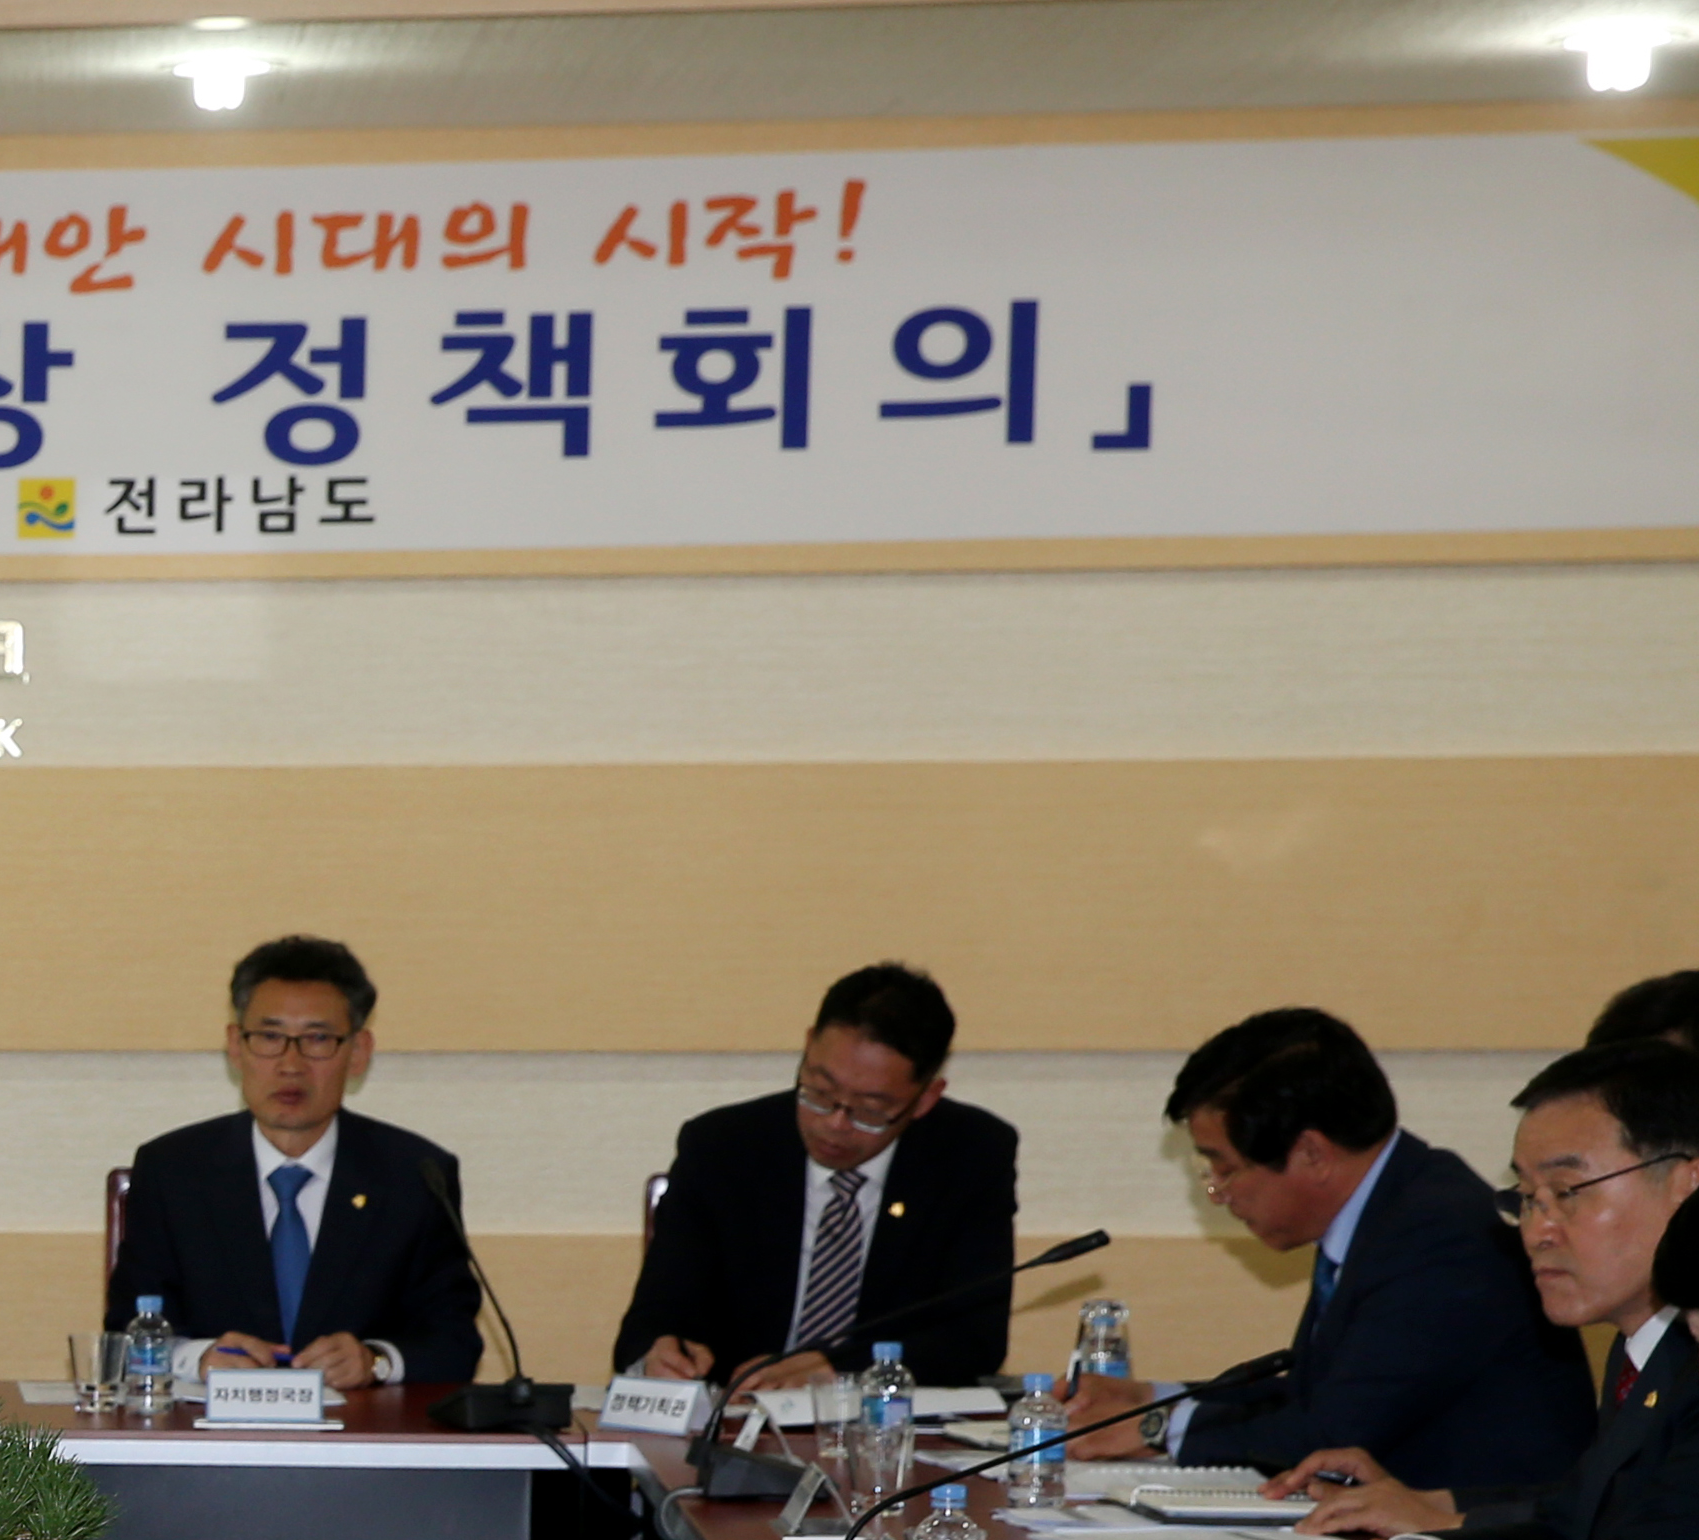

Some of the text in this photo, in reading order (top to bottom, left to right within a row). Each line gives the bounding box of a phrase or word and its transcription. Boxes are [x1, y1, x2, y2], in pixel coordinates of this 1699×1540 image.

[201, 200, 531, 278] 시대의
[592, 178, 868, 281] 시작!
[212, 301, 1152, 467] 정책회의」
[105, 474, 376, 536] 전라남도
